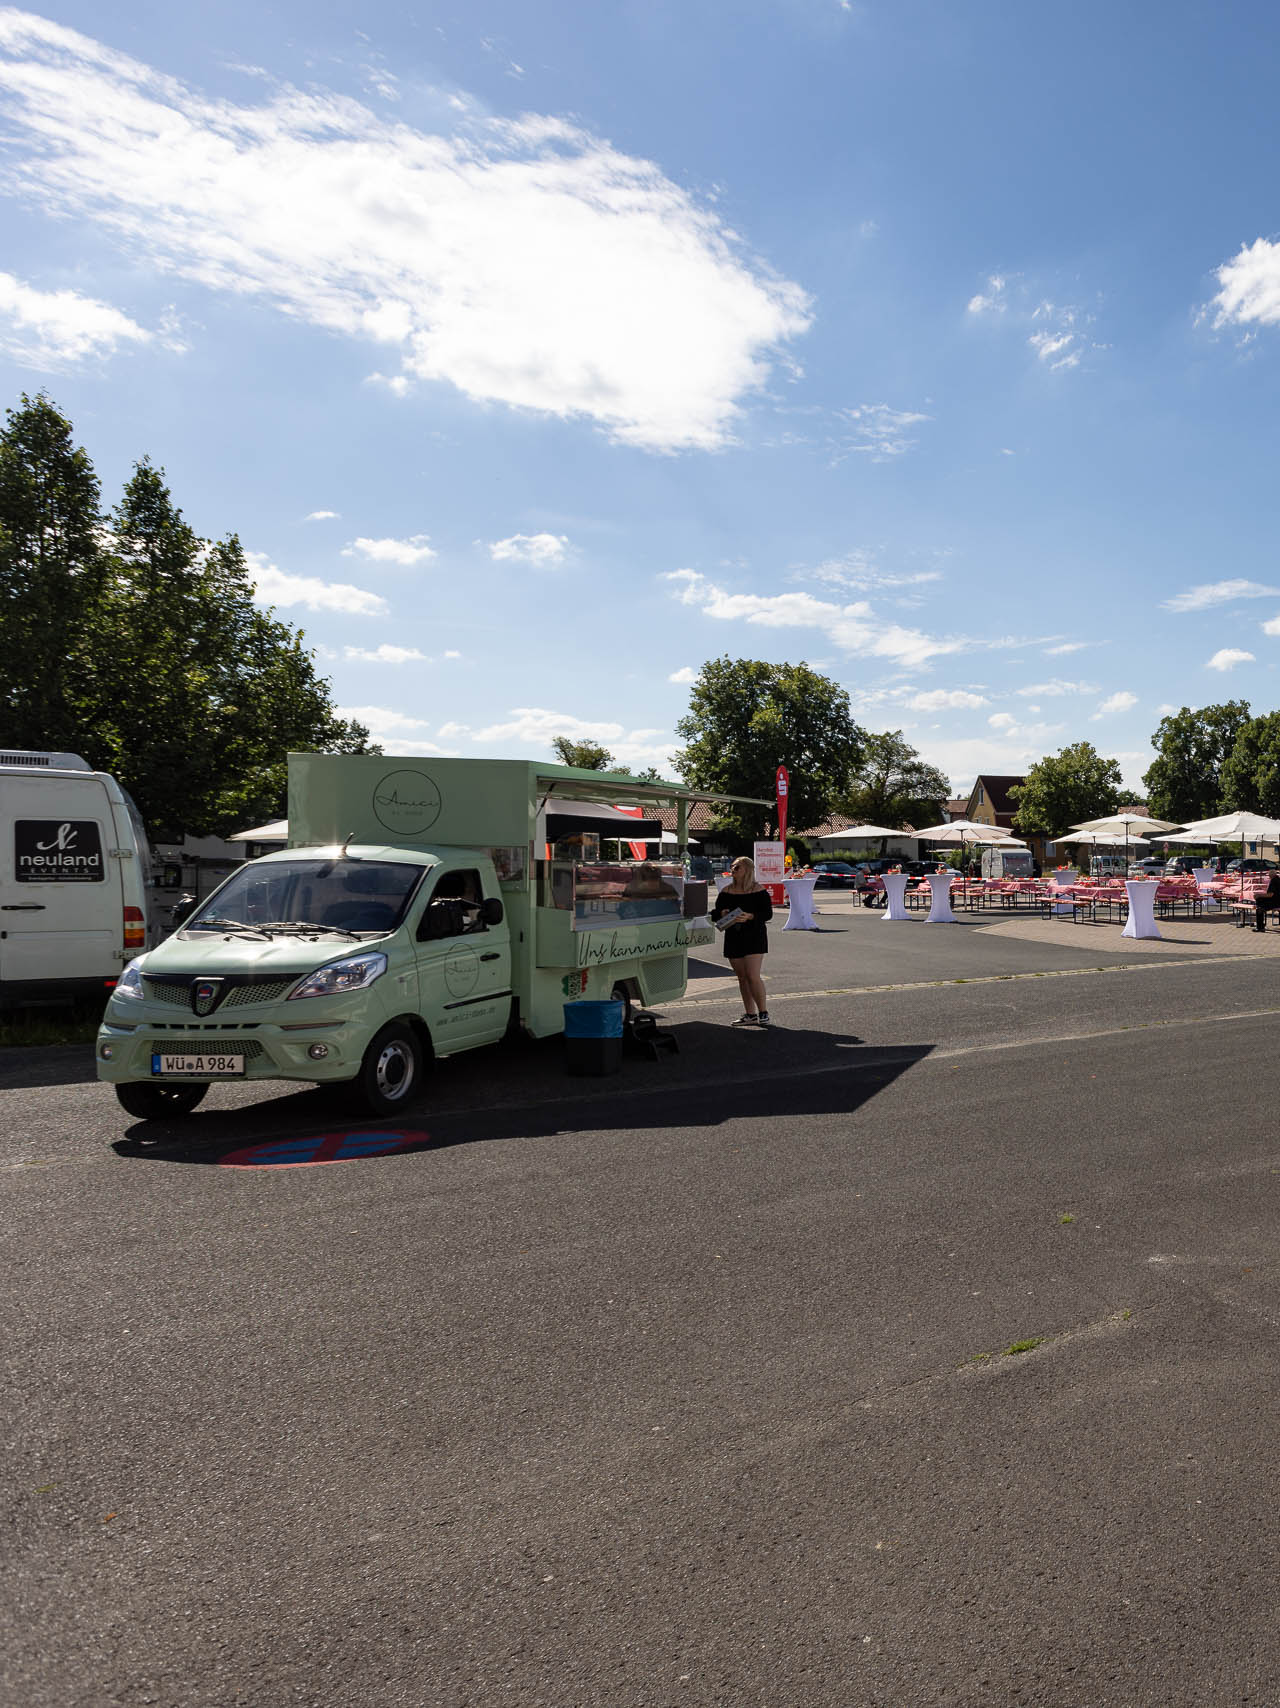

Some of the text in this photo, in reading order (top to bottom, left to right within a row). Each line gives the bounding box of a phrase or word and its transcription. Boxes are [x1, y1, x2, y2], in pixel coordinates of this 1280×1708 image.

[20, 853, 99, 866] neuland
[579, 931, 607, 966] Uns
[610, 930, 645, 958] kann
[645, 939, 673, 954] man
[166, 1057, 236, 1071] WÜ A 984
